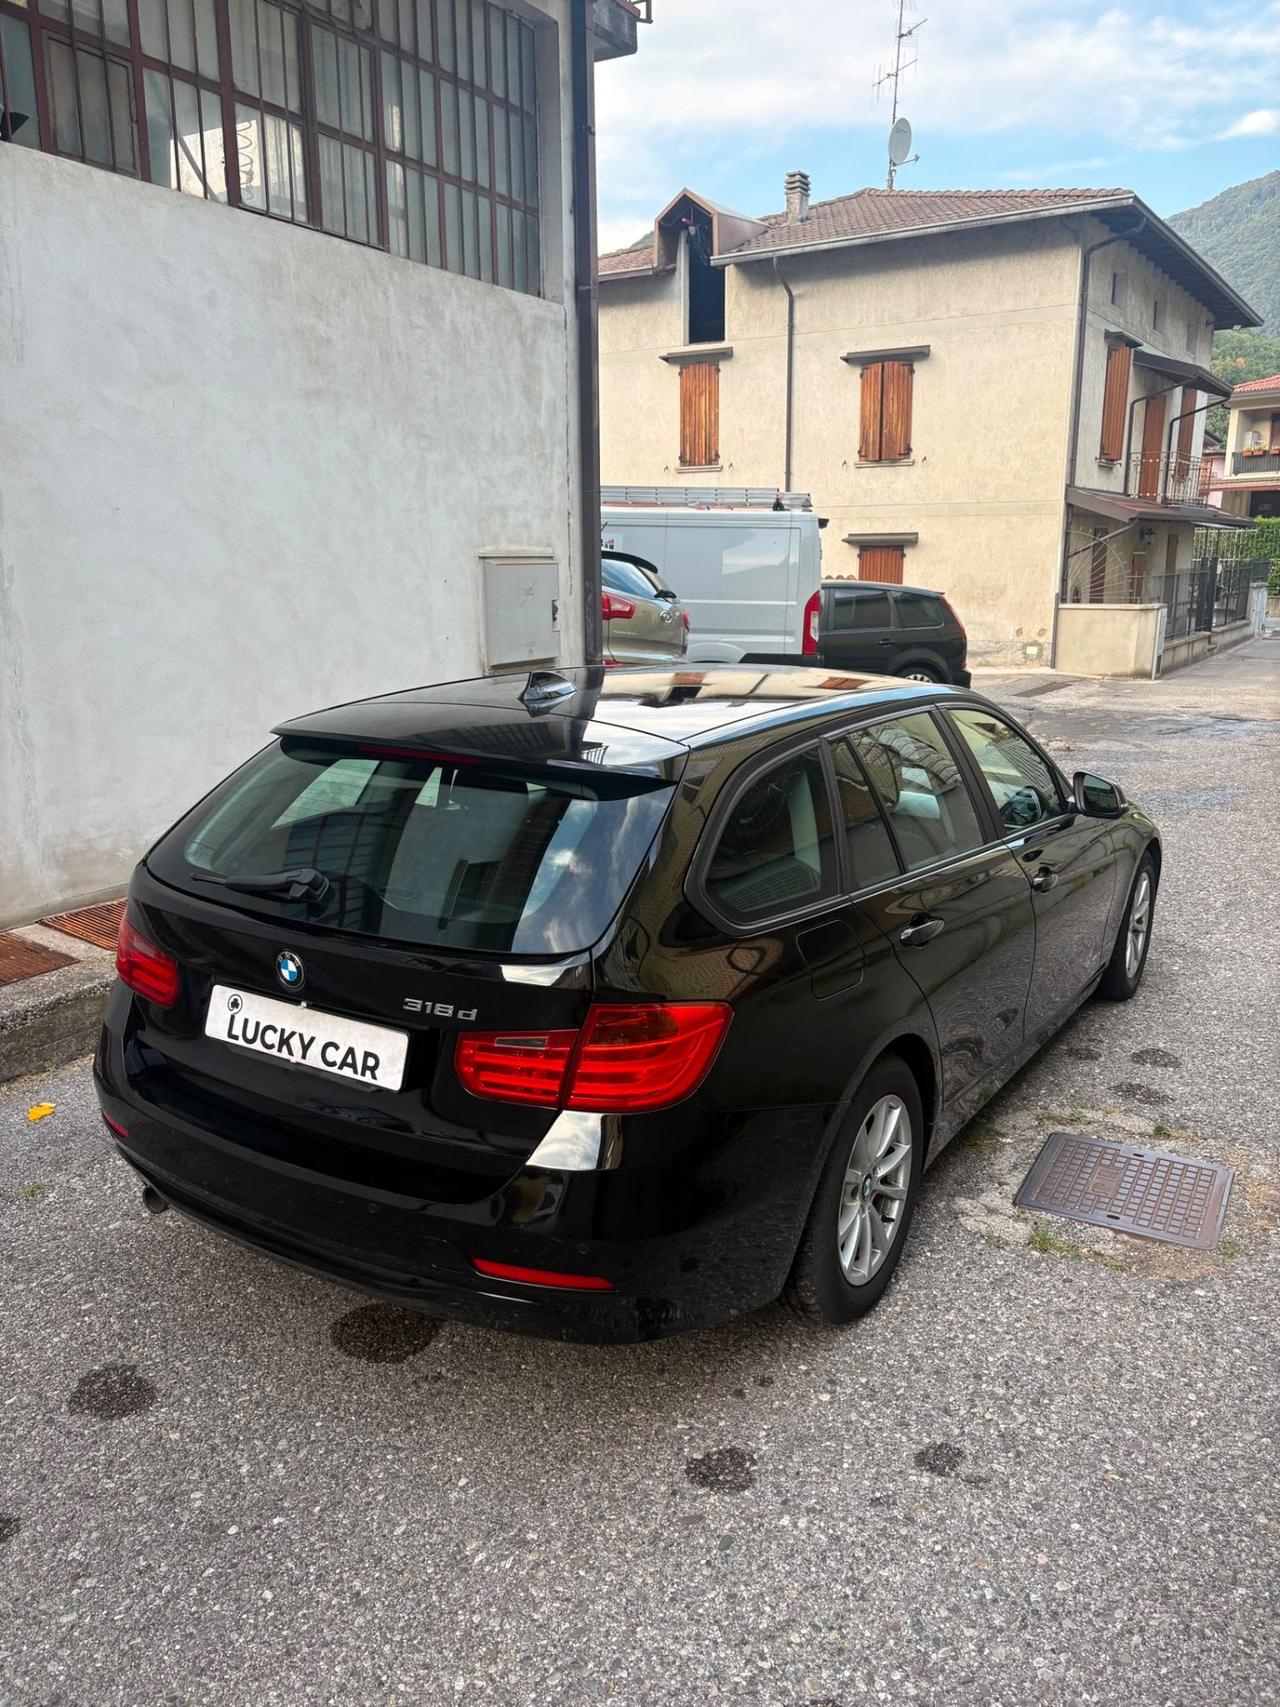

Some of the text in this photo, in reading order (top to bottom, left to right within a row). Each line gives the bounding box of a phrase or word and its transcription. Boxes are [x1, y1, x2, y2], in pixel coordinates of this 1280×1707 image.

[402, 997, 478, 1022] 318d
[227, 1014, 380, 1080] LUCKY CAR
